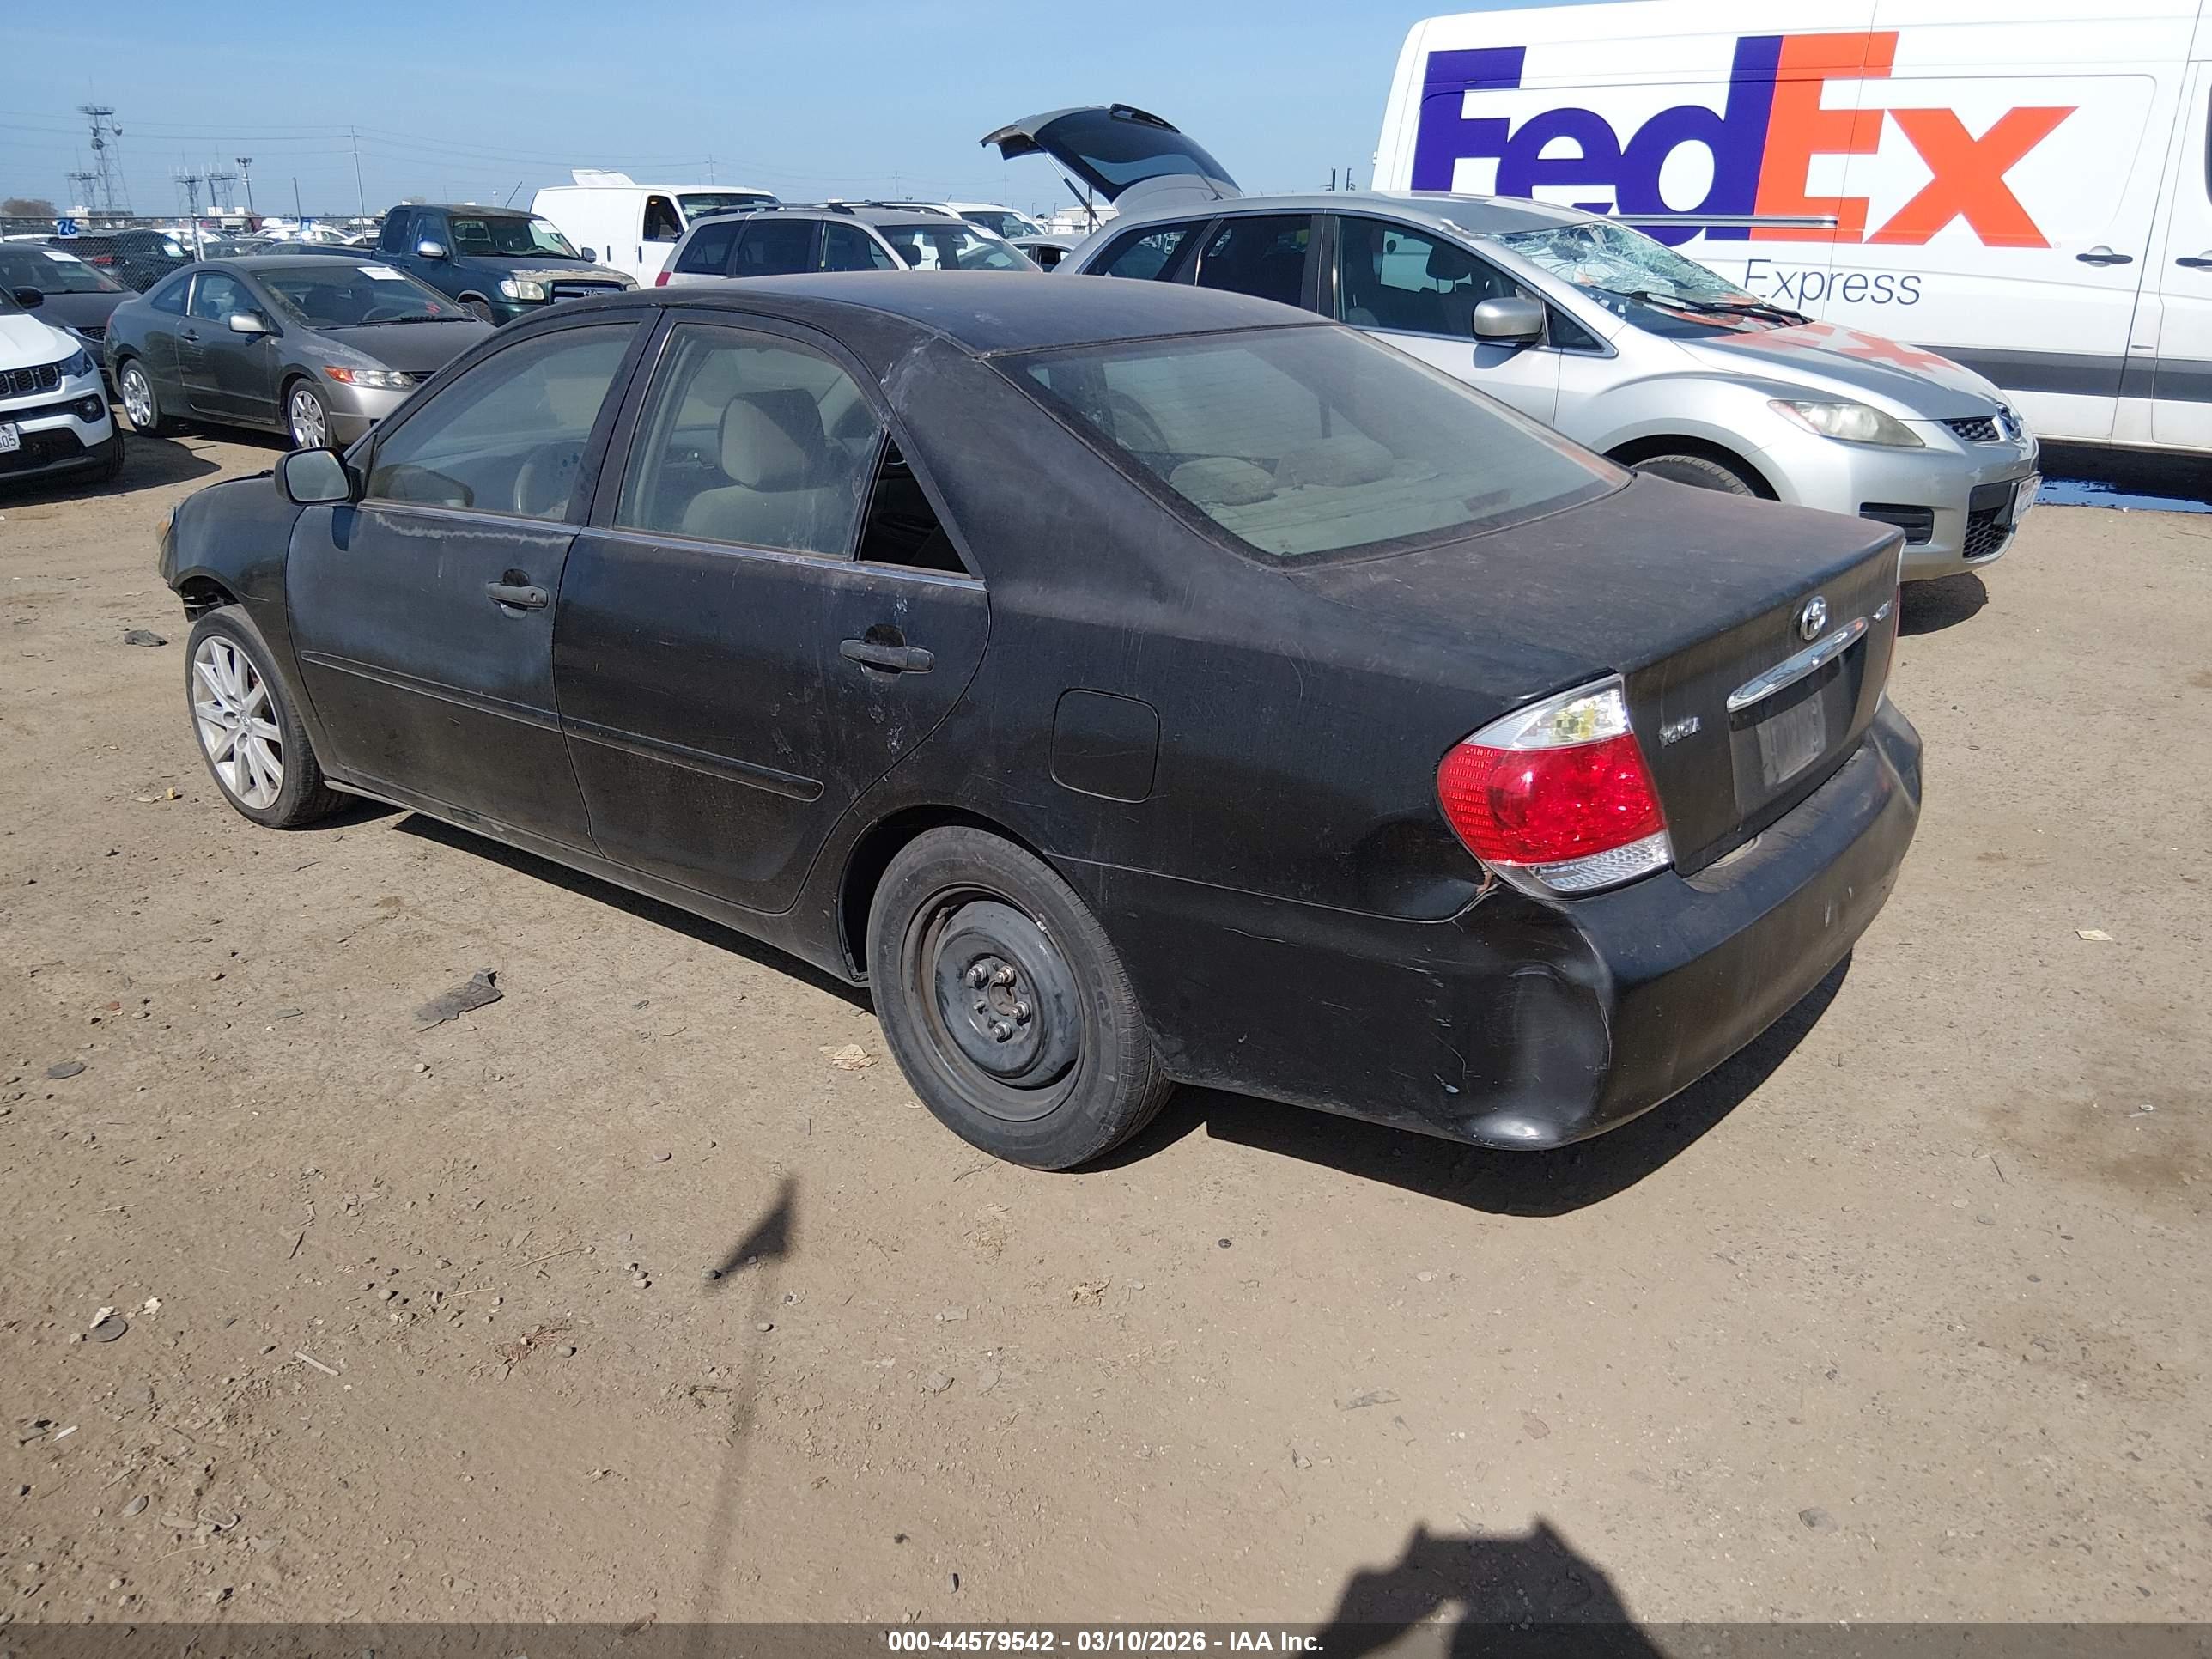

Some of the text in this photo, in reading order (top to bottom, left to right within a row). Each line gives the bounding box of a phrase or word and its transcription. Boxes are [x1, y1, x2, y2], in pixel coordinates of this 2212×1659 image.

[1410, 31, 2079, 248] FedEx
[58, 220, 77, 235] 26
[1745, 259, 1922, 310] Express
